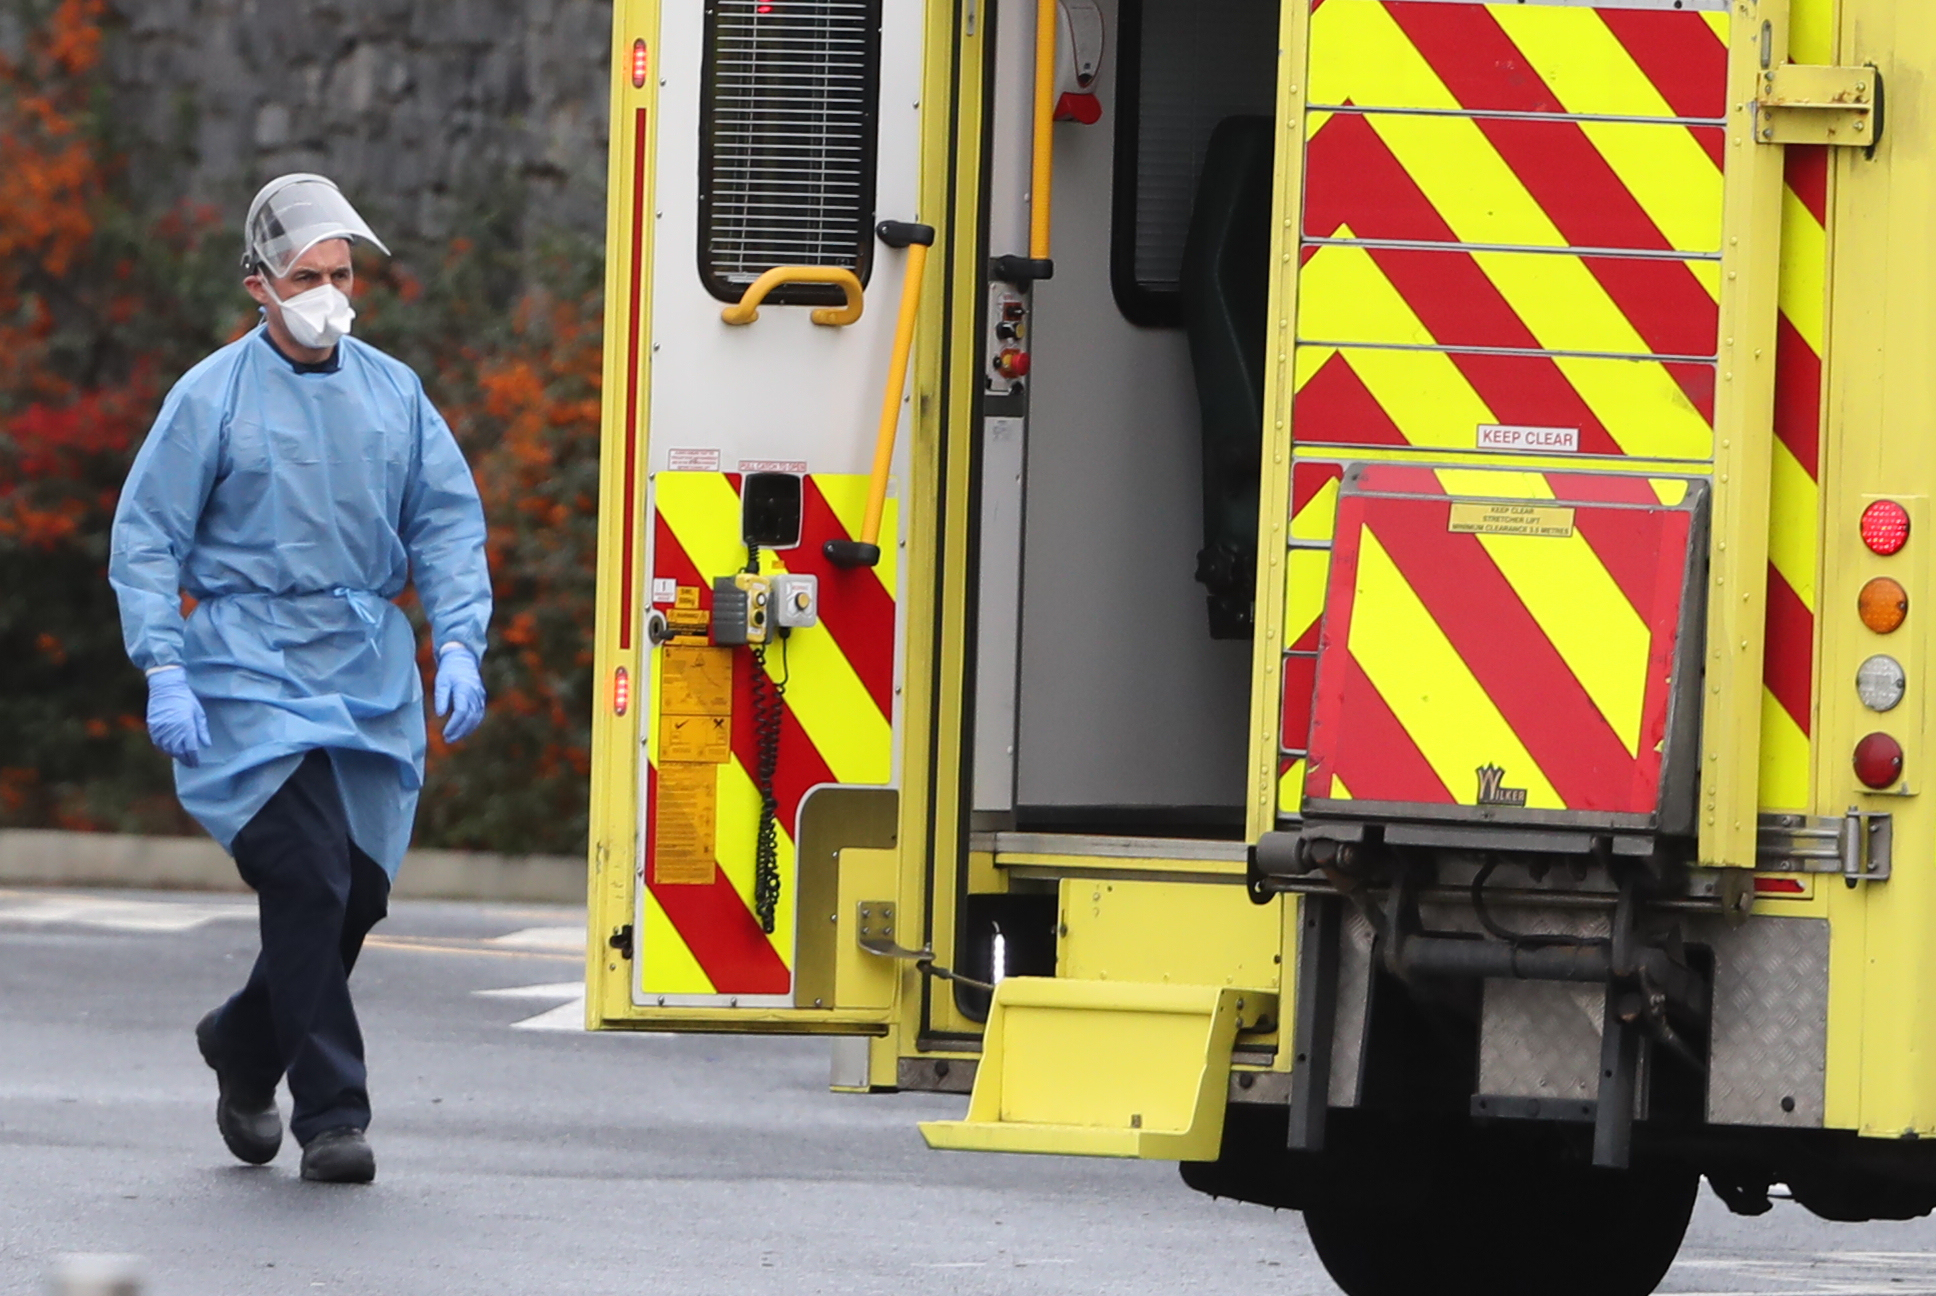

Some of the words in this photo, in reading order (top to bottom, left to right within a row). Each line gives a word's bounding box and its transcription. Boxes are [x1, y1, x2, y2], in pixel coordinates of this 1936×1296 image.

[1483, 429, 1521, 444] KEEP
[1525, 431, 1573, 446] CLEAR
[1482, 515, 1524, 523] STRETCHER
[1478, 768, 1526, 801] WILKER
